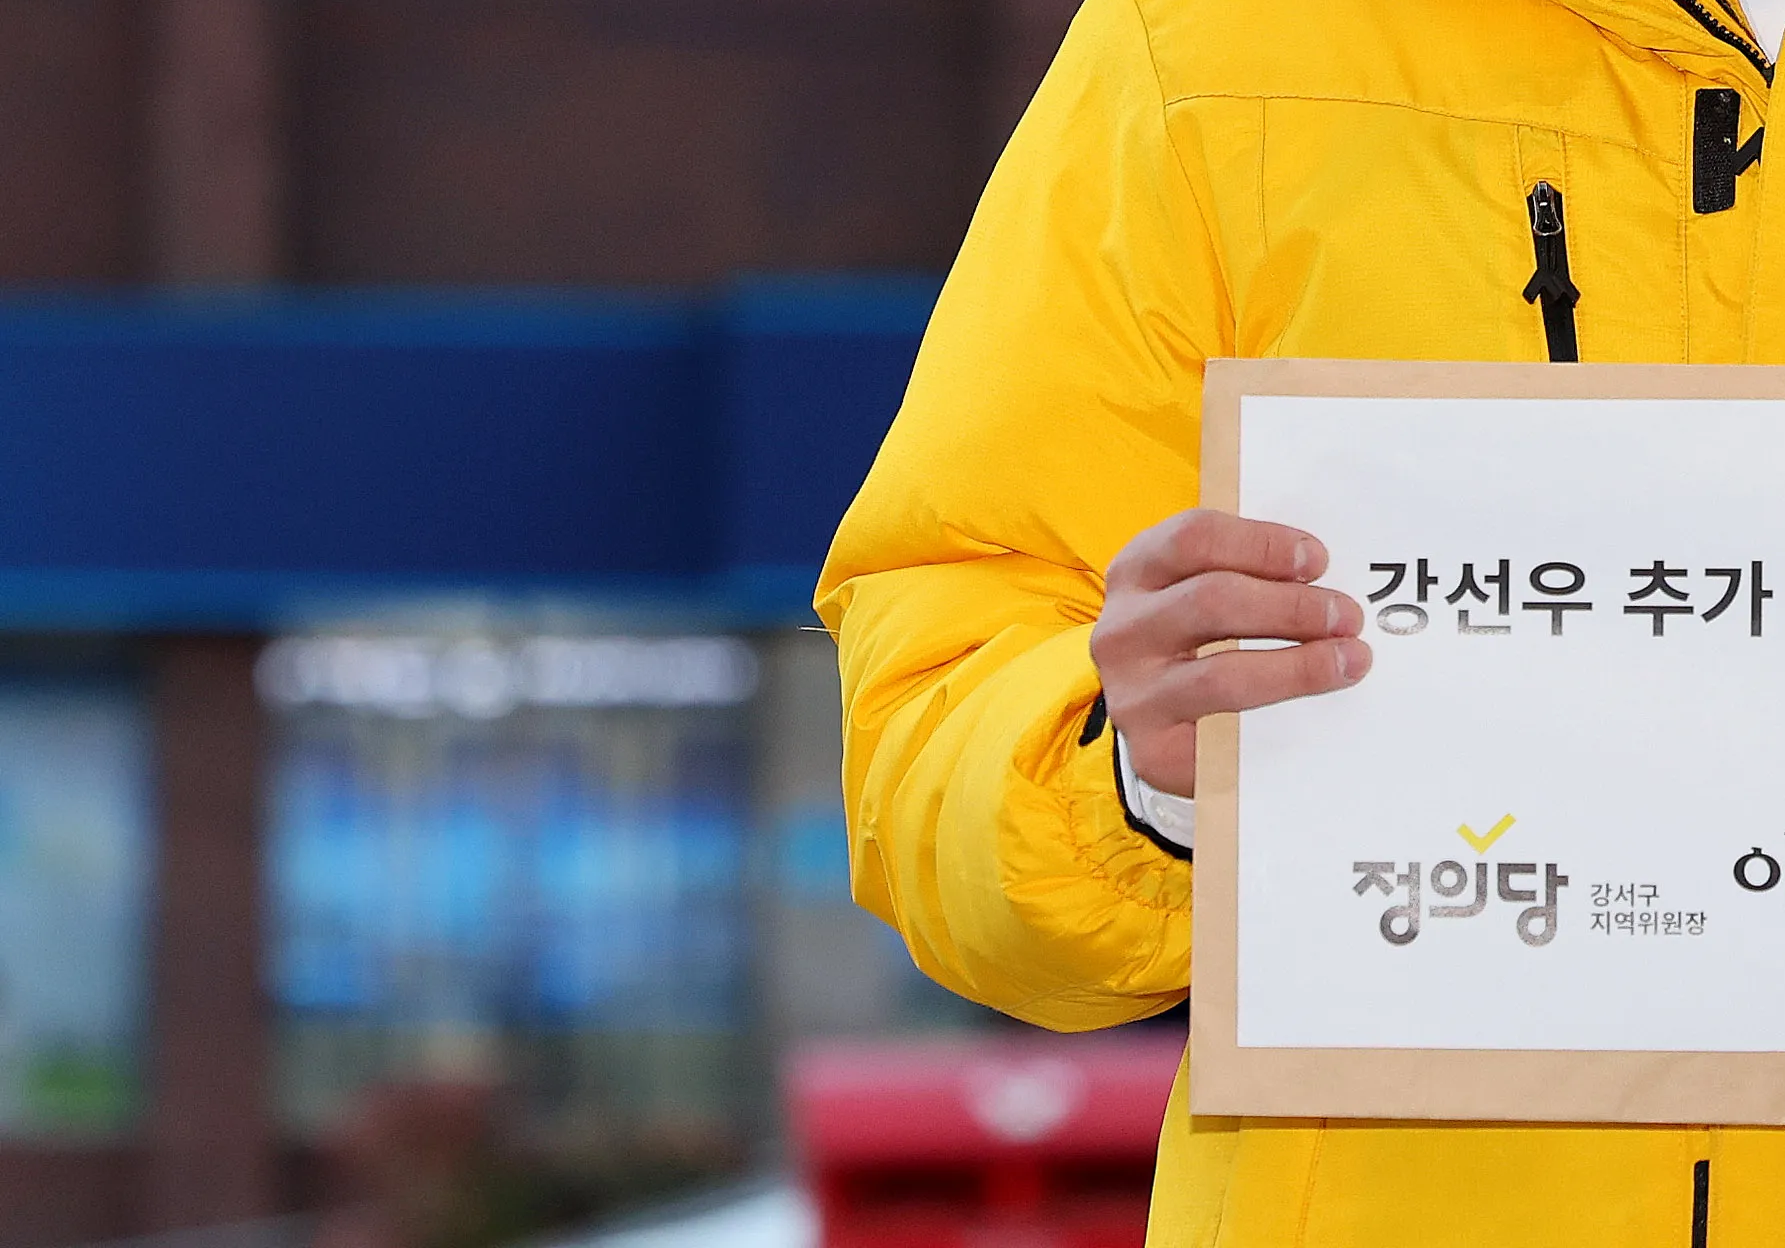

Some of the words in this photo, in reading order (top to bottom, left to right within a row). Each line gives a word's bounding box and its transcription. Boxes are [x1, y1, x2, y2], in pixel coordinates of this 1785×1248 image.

[1366, 558, 1594, 637] 강선우
[1623, 560, 1774, 639] 추가
[1352, 858, 1569, 947] 정의당
[1590, 883, 1660, 907] 강서구
[1590, 911, 1707, 936] 지역위원장
